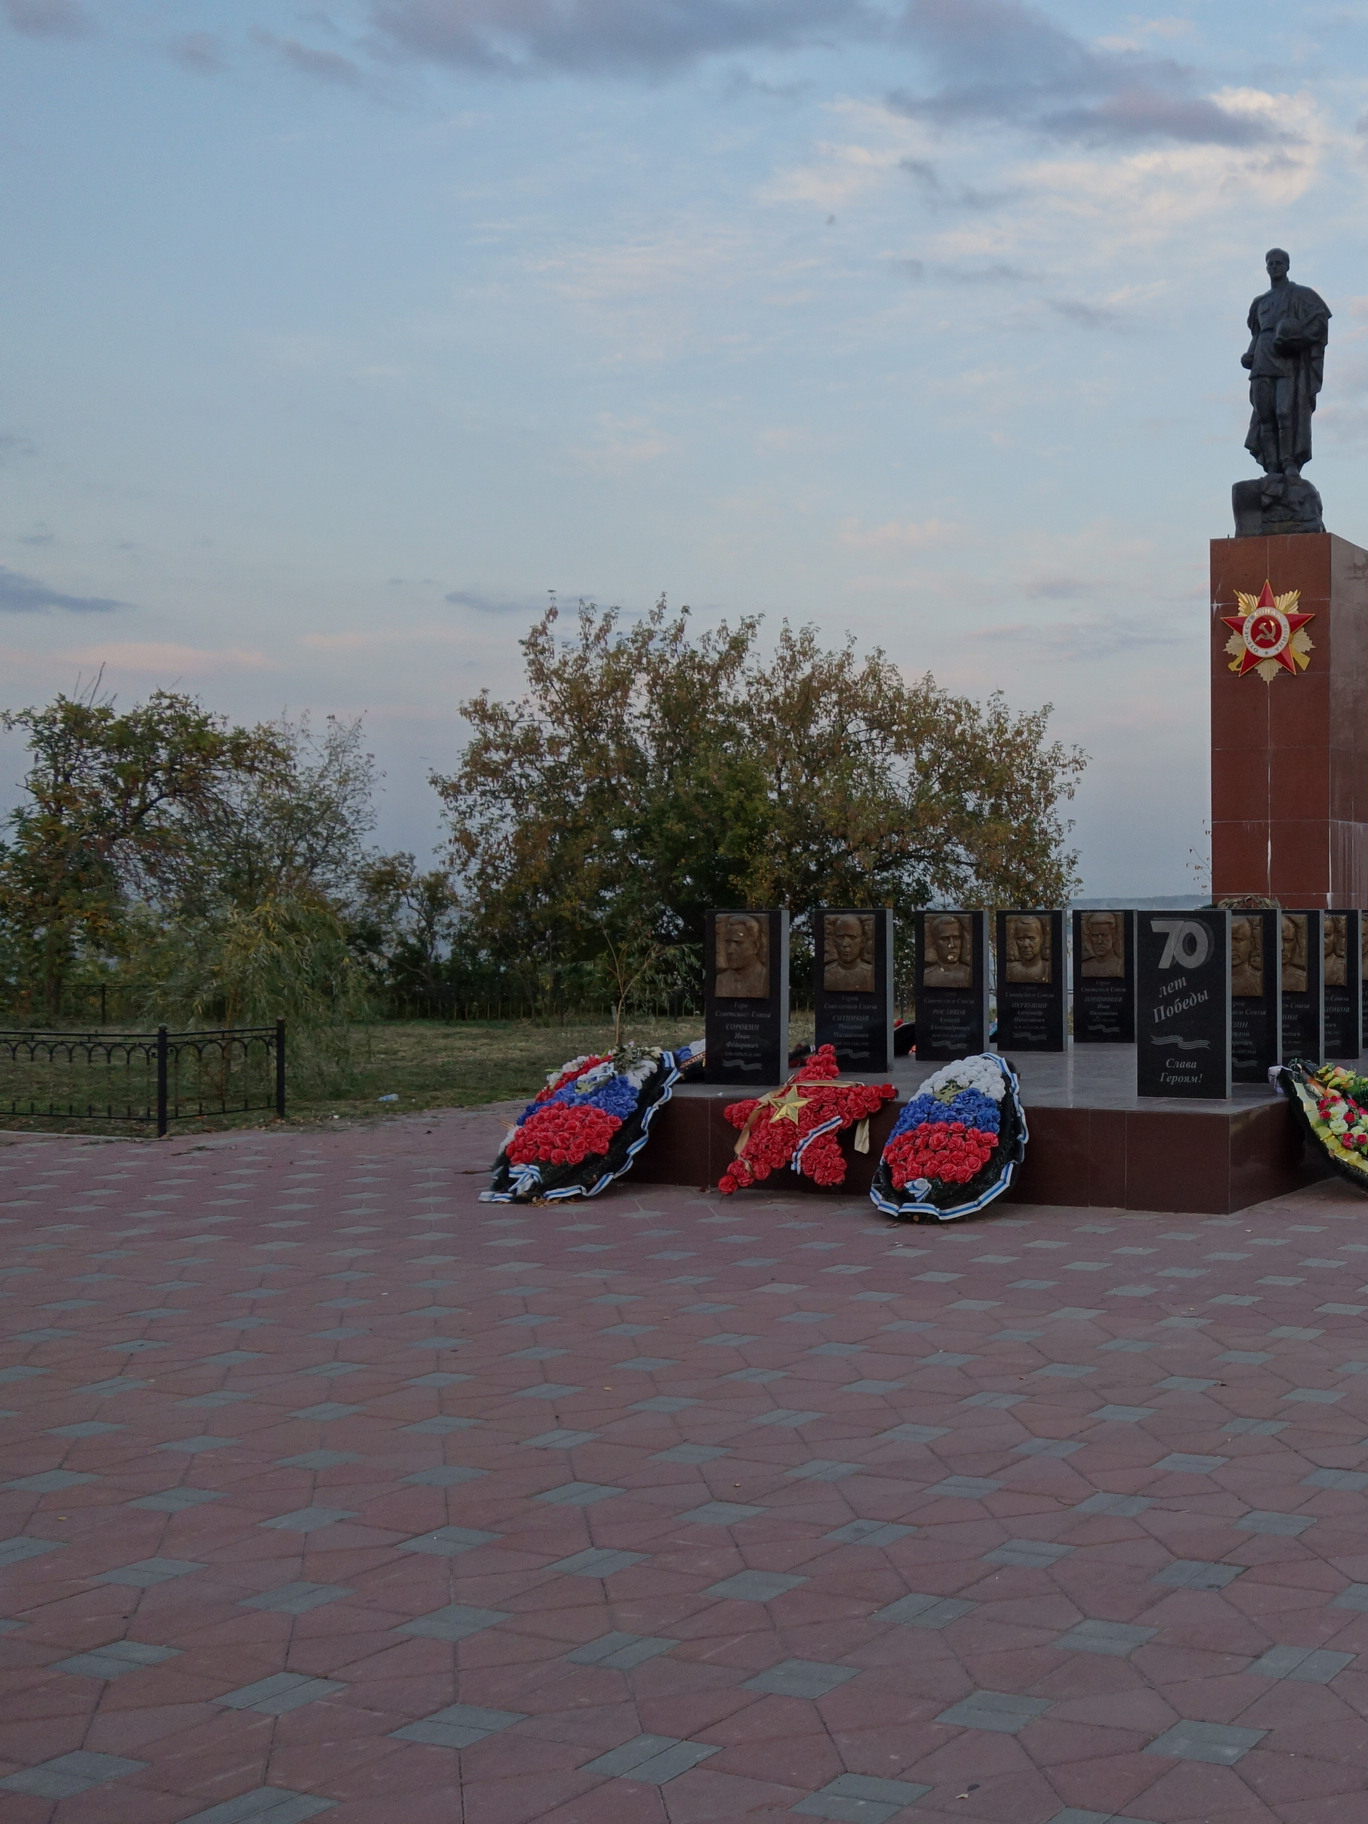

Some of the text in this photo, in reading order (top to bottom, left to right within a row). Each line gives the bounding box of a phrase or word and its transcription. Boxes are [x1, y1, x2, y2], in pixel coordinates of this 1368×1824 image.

[1150, 919, 1210, 969] 70
[1159, 976, 1187, 998] лет
[1152, 989, 1209, 1024] Победы
[725, 1023, 760, 1031] СОРОКИН
[1166, 1057, 1198, 1069] Слава
[1160, 1072, 1204, 1086] Героям!
